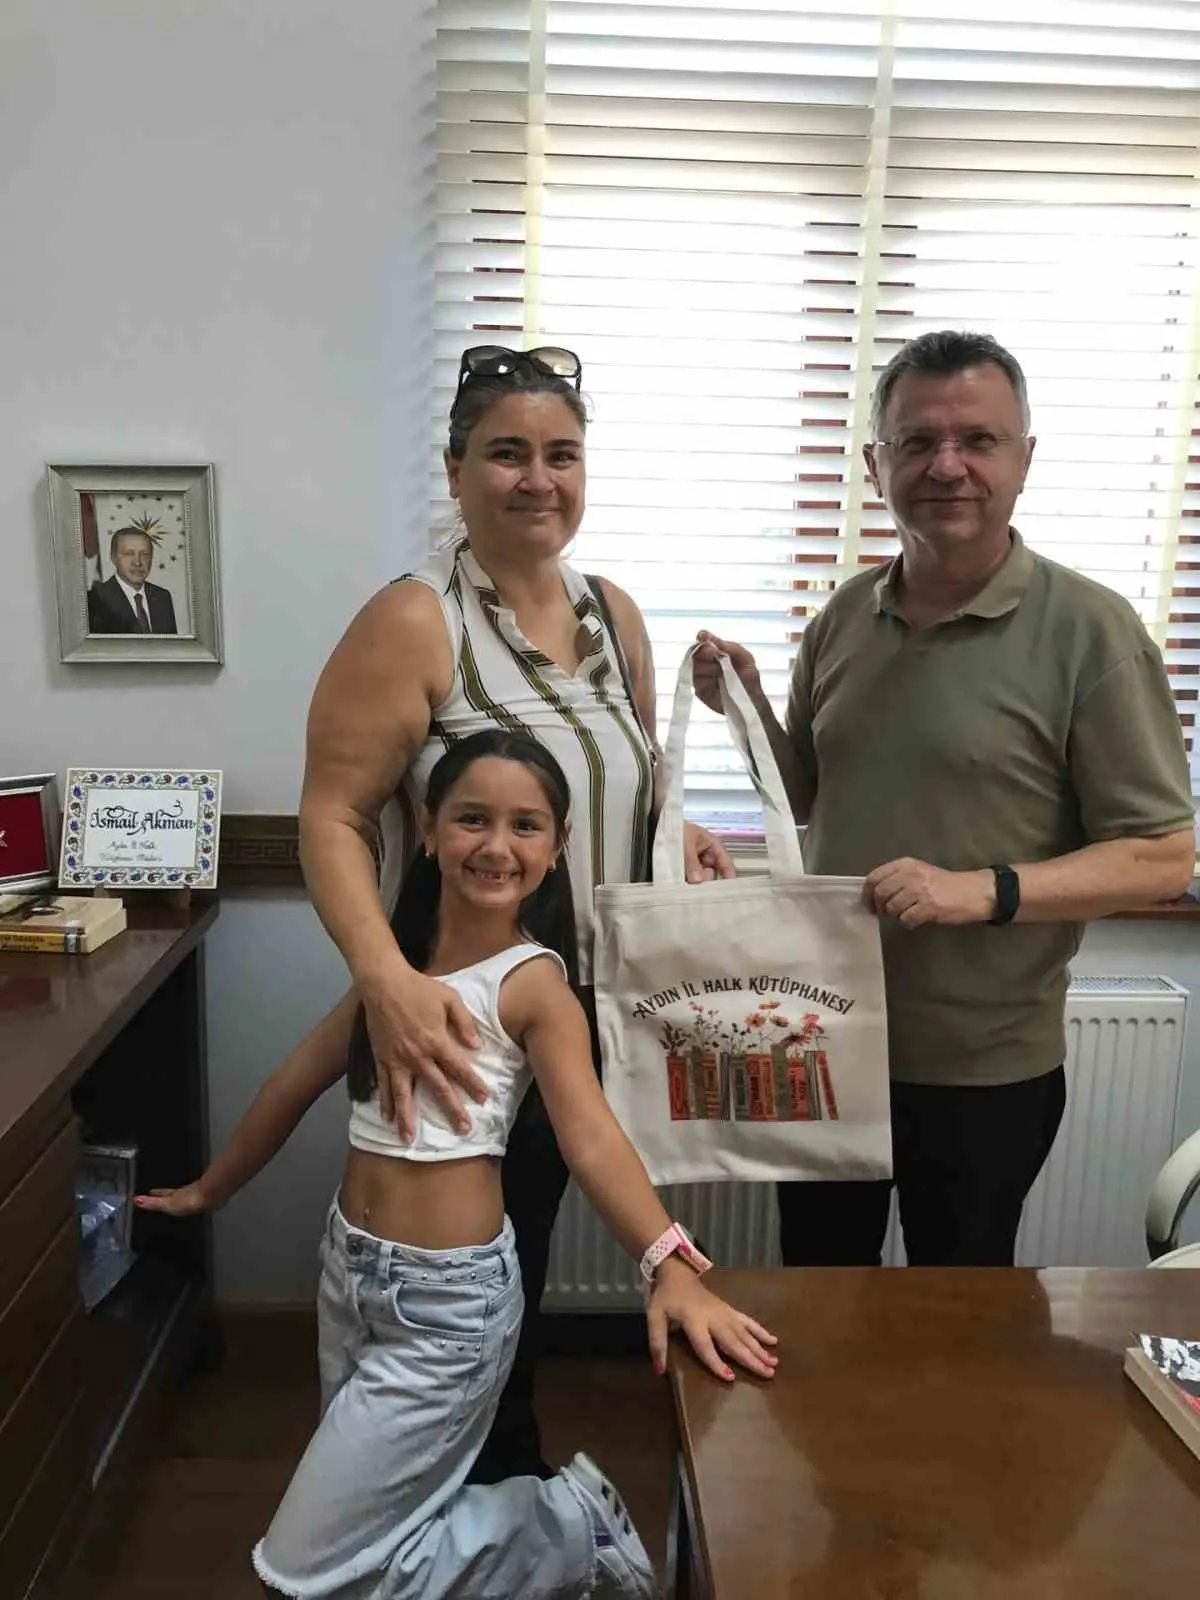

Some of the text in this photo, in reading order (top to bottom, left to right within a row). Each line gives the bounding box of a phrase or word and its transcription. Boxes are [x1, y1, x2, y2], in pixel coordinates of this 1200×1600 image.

[137, 801, 195, 833] Akman
[632, 975, 856, 1019] AYDIN İL HALK KÜTÜPHANESİ
